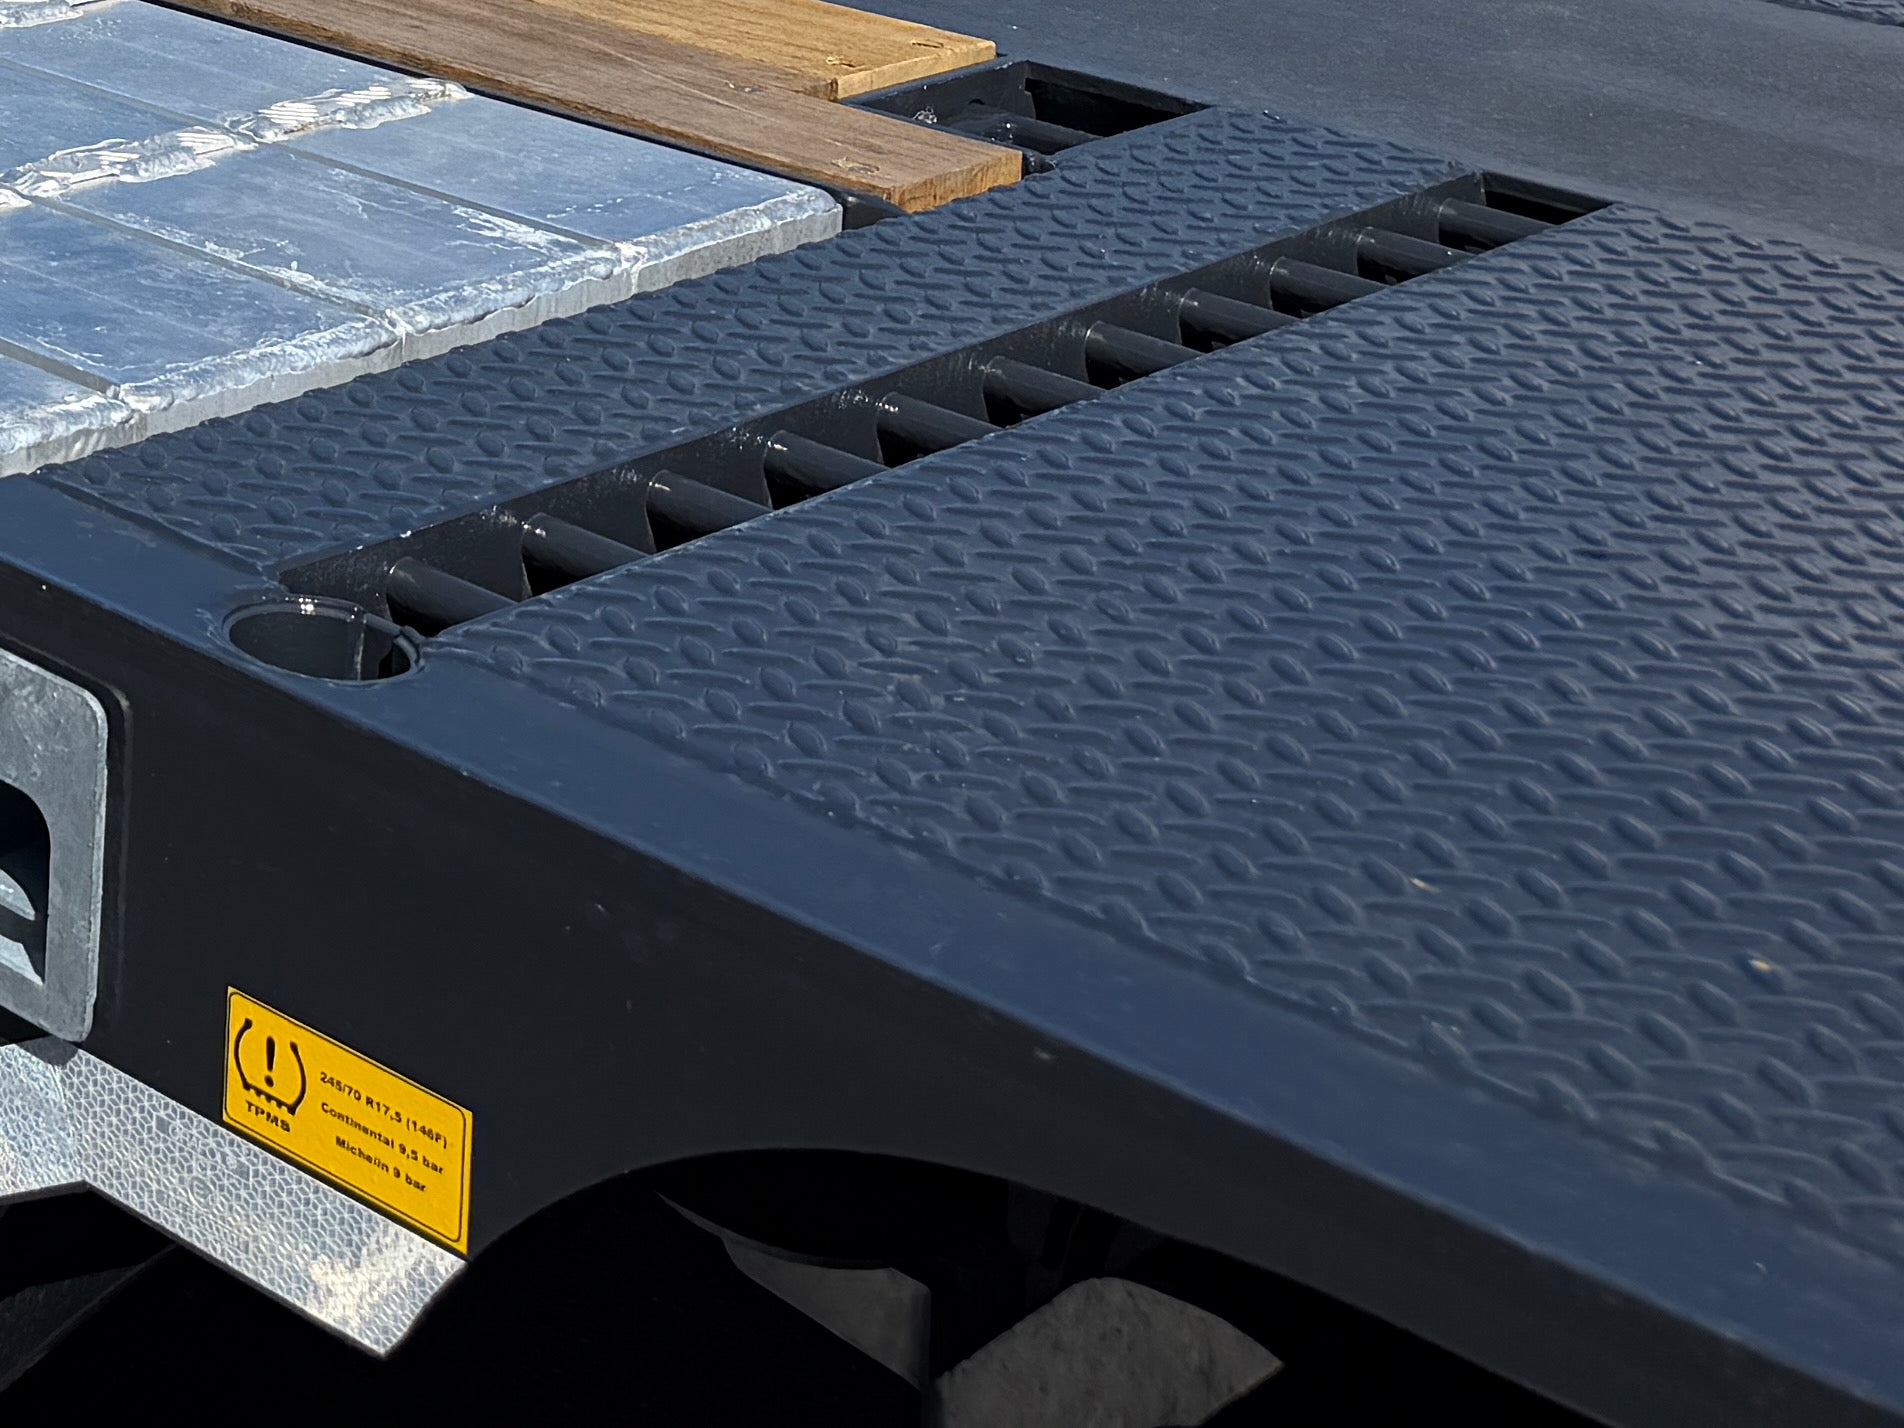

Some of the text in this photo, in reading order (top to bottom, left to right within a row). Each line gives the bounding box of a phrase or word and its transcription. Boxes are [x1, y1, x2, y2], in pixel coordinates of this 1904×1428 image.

[319, 1071, 362, 1102] 245/70
[245, 1099, 291, 1133] TPMS
[321, 1101, 444, 1174] Continental 9,5 bar
[335, 1135, 390, 1173] Michelin
[405, 1173, 427, 1192] bar
